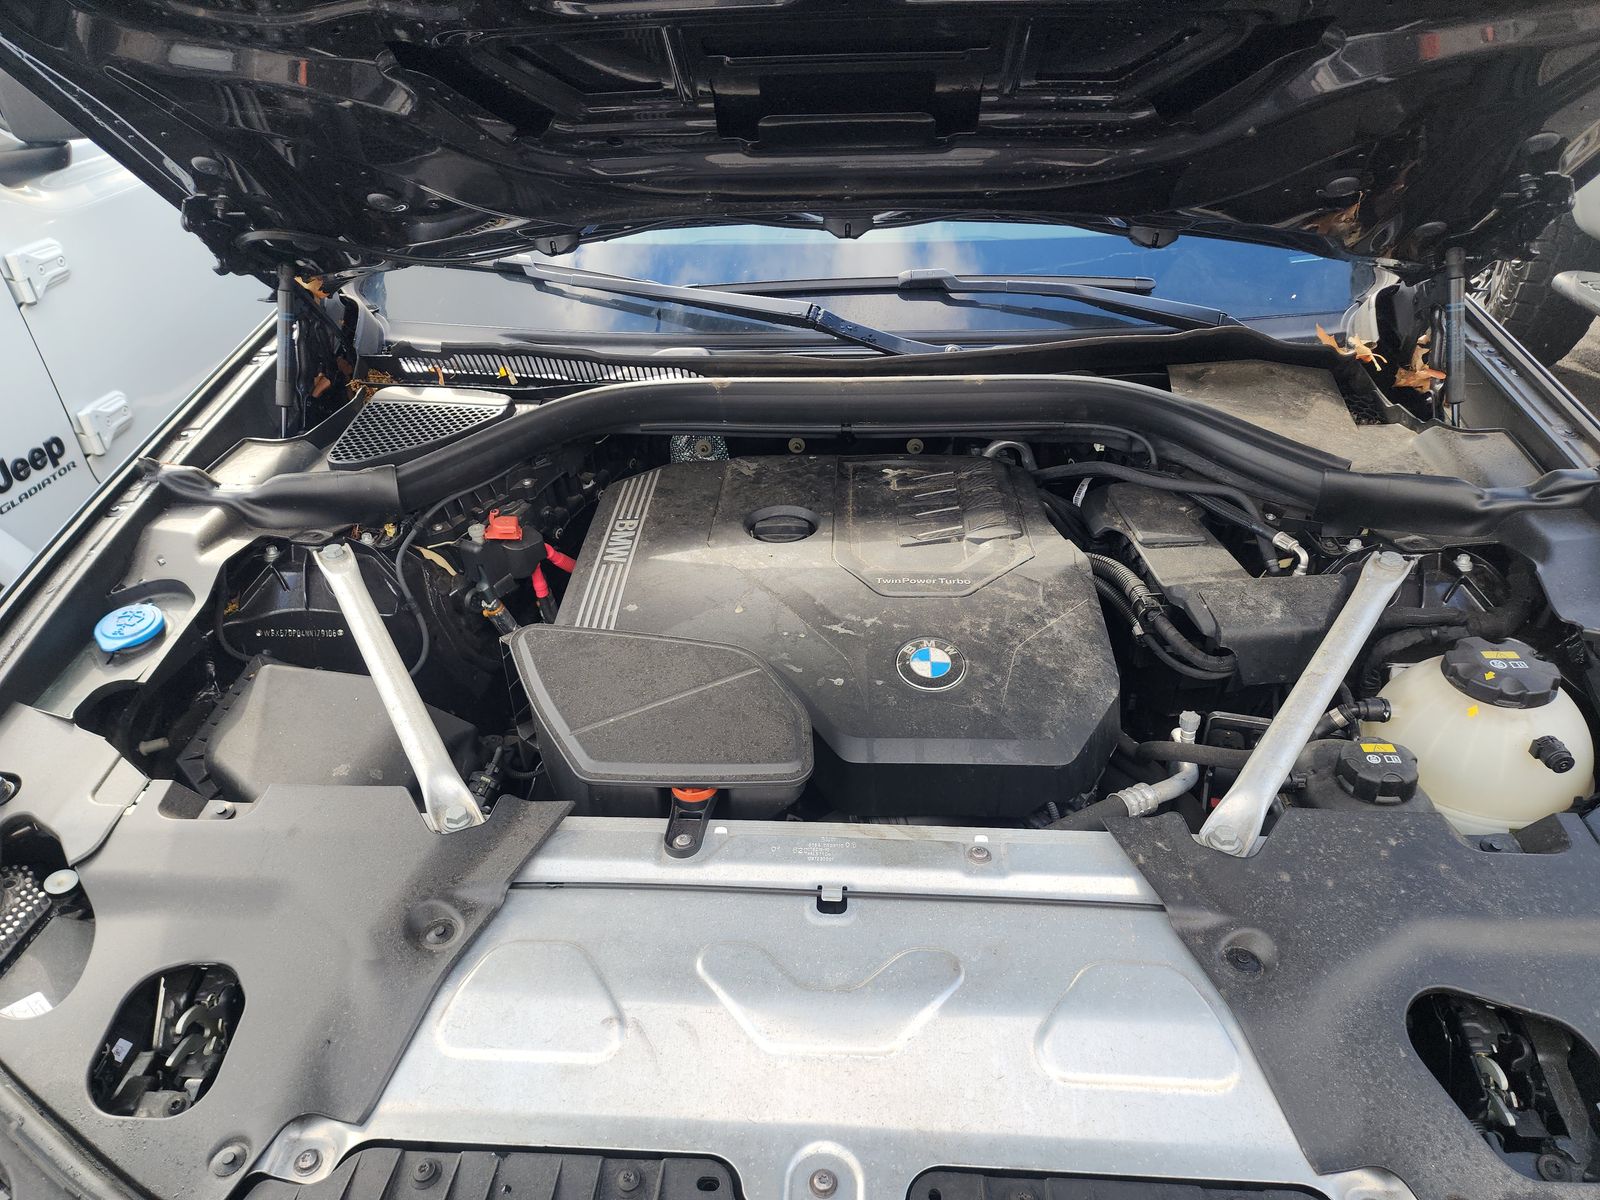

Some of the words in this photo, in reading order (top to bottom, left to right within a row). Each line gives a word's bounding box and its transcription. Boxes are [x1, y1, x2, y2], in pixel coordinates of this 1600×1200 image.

[0, 436, 65, 494] Jeep
[0, 461, 77, 515] GLADIATOR
[603, 519, 639, 562] BMW
[876, 577, 936, 585] TwinPower
[938, 577, 972, 585] Turbo
[903, 639, 958, 656] BMW
